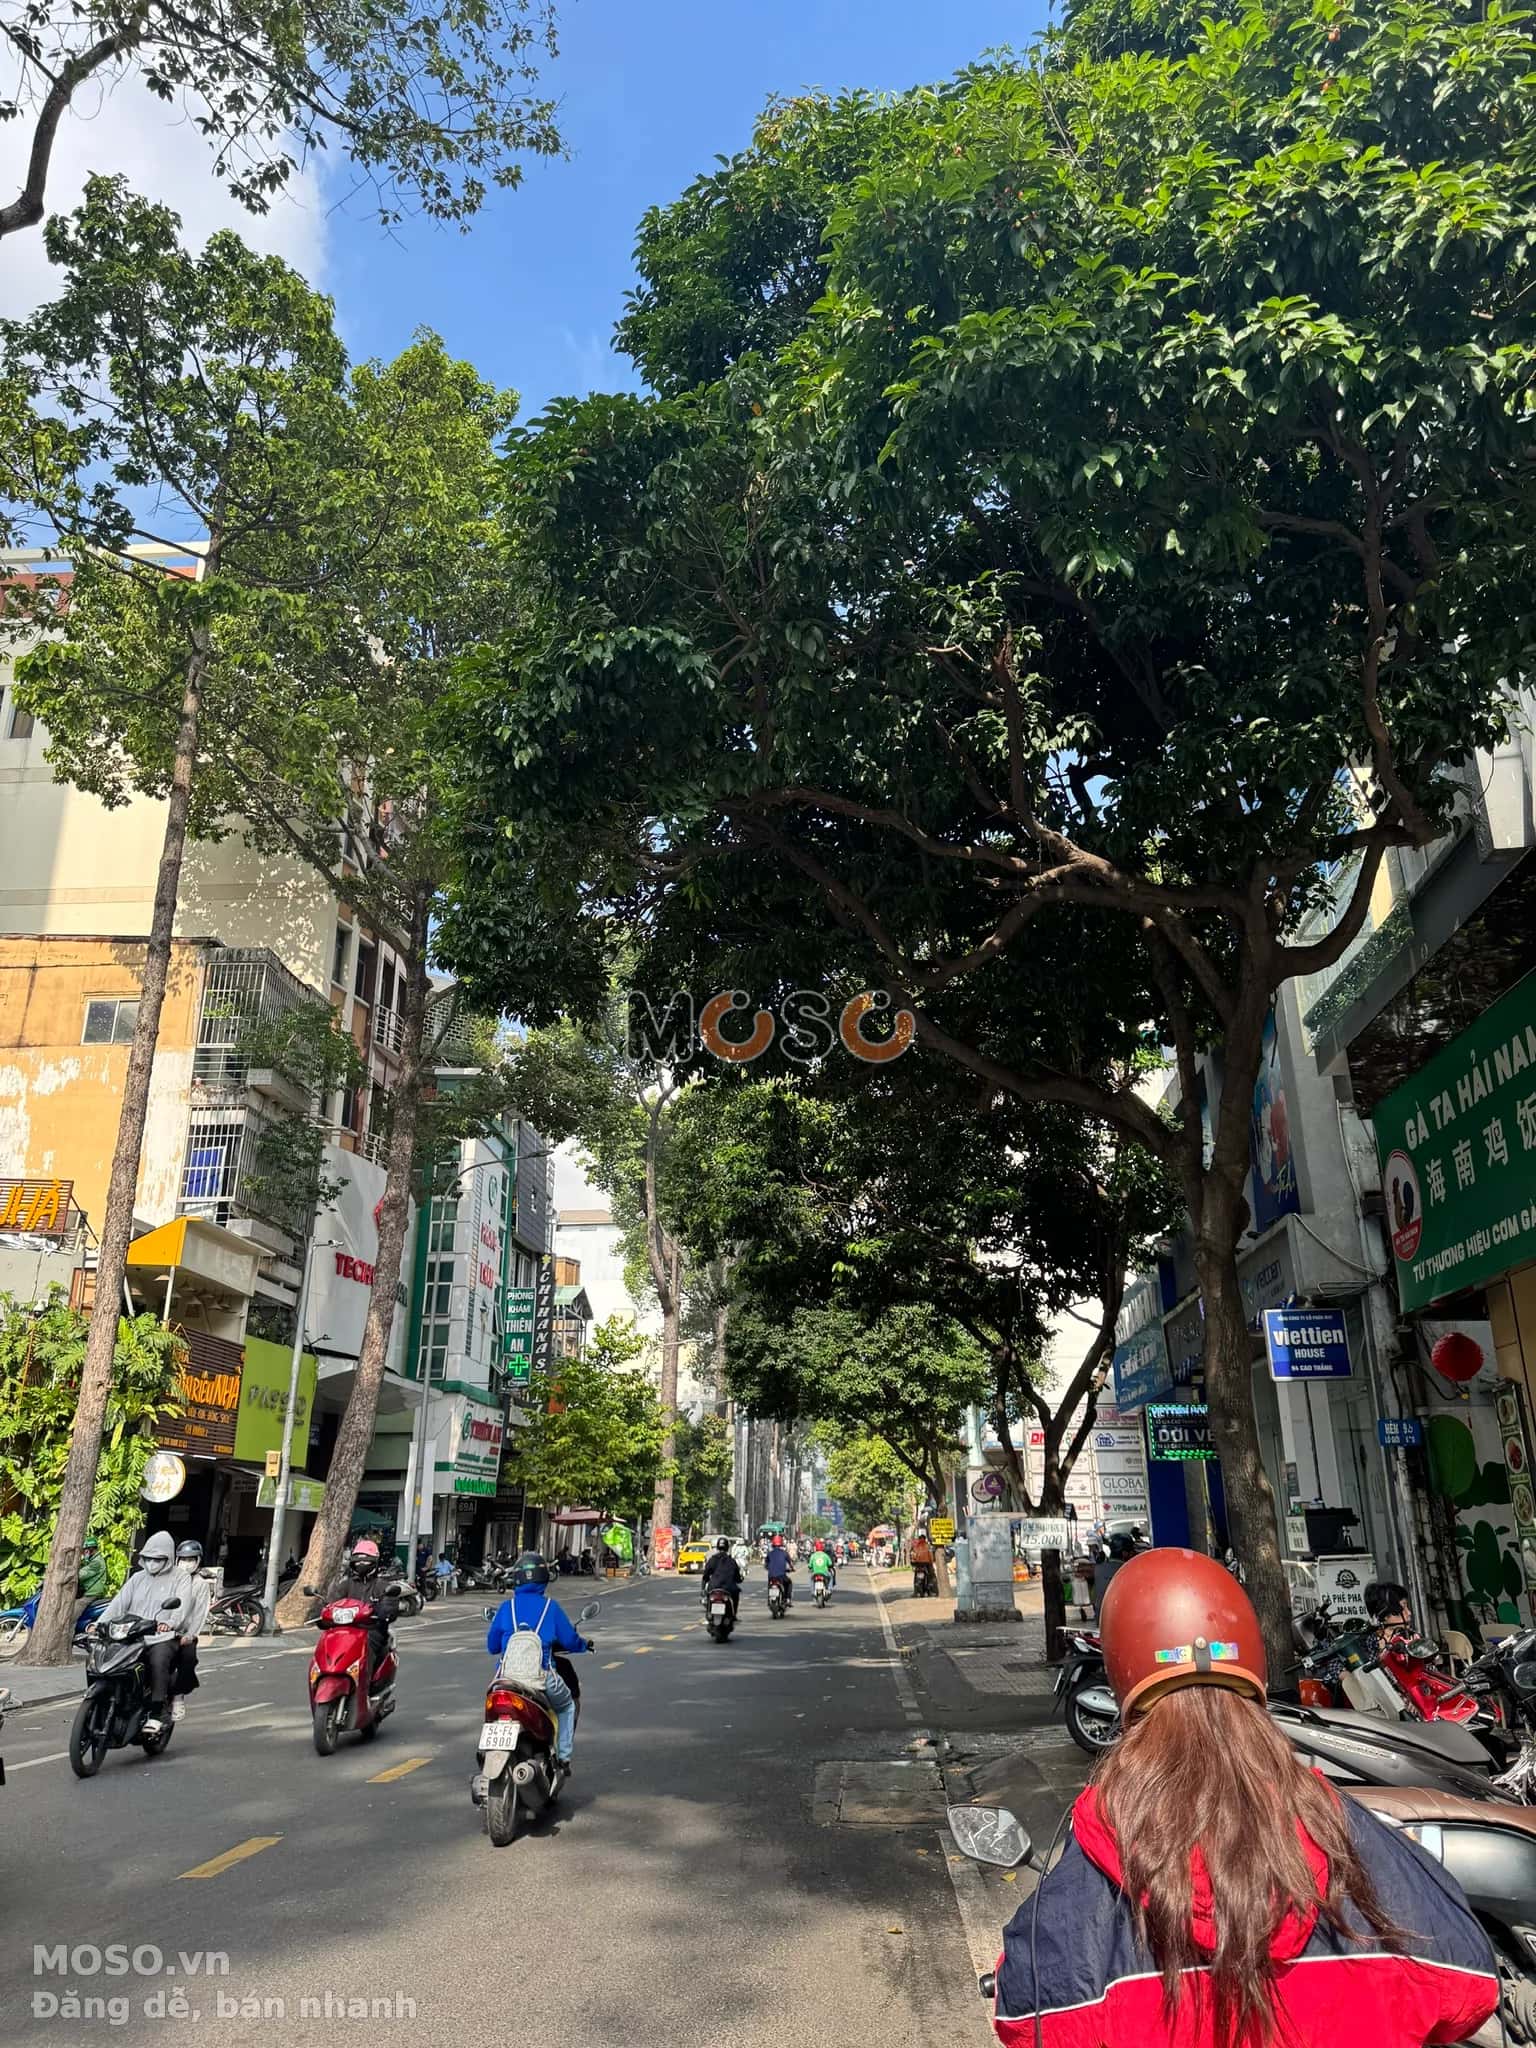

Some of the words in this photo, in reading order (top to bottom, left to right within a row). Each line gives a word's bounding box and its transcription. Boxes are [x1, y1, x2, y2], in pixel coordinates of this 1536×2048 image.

[1404, 1101, 1430, 1150] GÀ
[1429, 1090, 1456, 1130] TA
[1456, 1049, 1494, 1113] HẢI
[1466, 1228, 1491, 1259] HIỆU
[1492, 1213, 1520, 1241] CƠM
[335, 1251, 374, 1286] TECH
[505, 1317, 532, 1333] THIÊN
[1273, 1327, 1344, 1346] viettien
[510, 1338, 524, 1352] AN
[1294, 1348, 1326, 1358] HOUSE
[1103, 1477, 1143, 1489] GLOBA
[1023, 1535, 1063, 1547] 15.000
[1347, 1593, 1362, 1602] PHA
[486, 1737, 512, 1747] 6900
